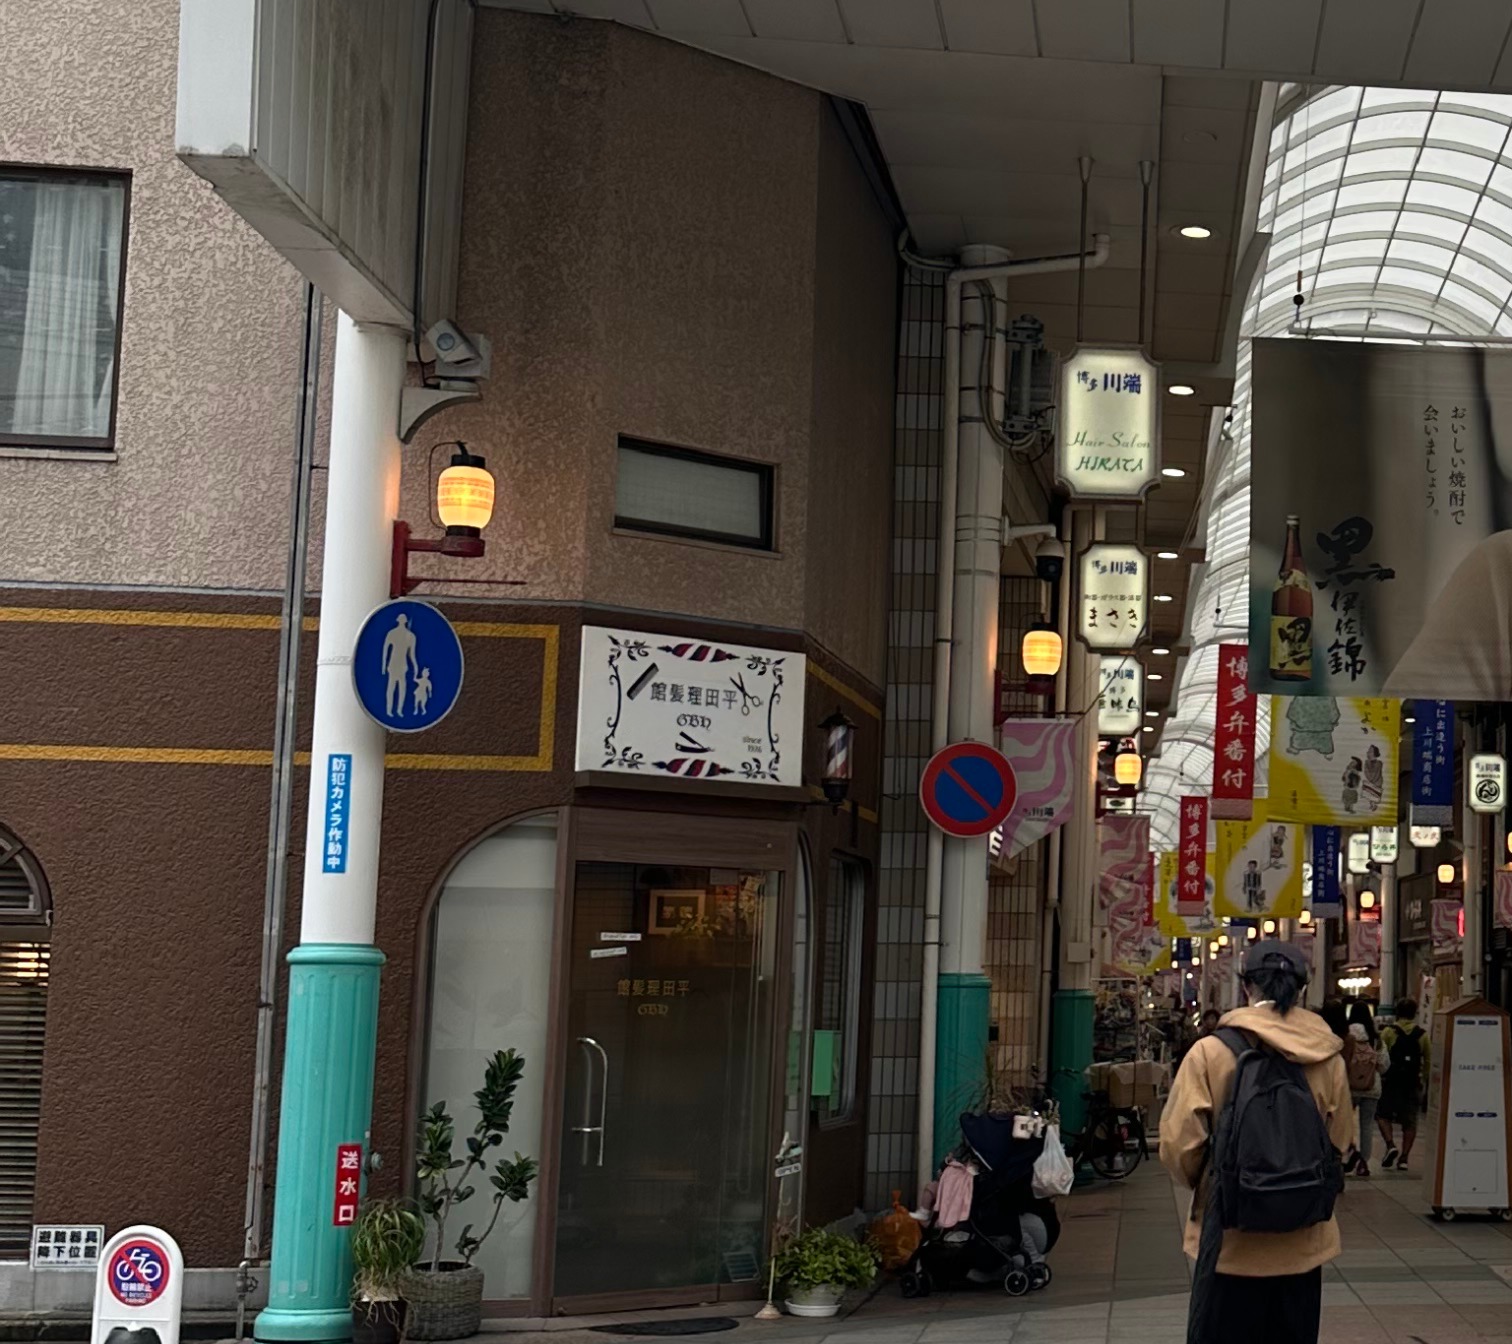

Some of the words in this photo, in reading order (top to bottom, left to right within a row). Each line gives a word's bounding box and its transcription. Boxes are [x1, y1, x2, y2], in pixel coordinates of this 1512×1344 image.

[1077, 370, 1142, 395] 博多川端
[1066, 430, 1105, 447] Hair
[1107, 432, 1150, 448] Salon
[1075, 456, 1144, 472] HIRATA
[1422, 404, 1441, 517] 会いましょう。
[1448, 405, 1467, 525] おいしい焼酎で
[1088, 606, 1139, 629] まさき
[1222, 656, 1251, 789] 博多弁番付
[326, 757, 348, 870] 防犯カメラ作動中
[340, 1150, 360, 1223] 送水口
[38, 1230, 98, 1244] 避難器具
[37, 1245, 98, 1259] 降下位置
